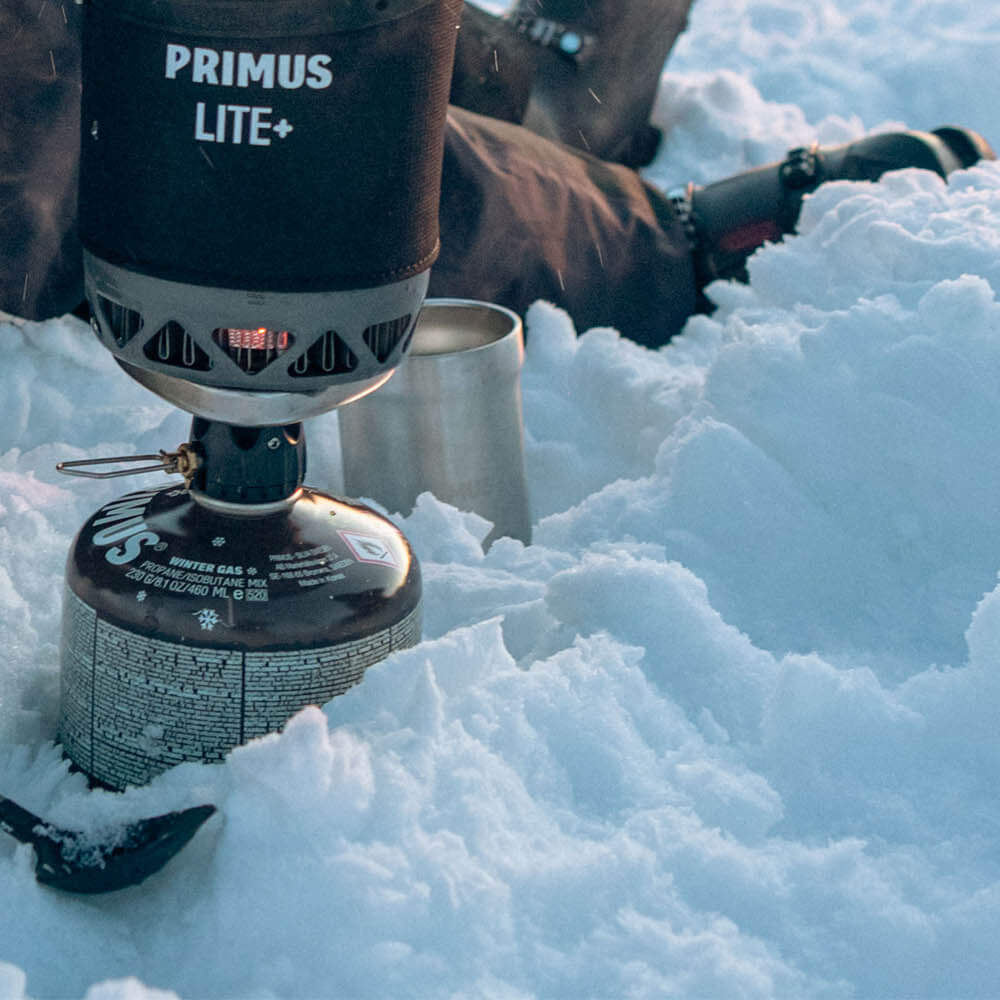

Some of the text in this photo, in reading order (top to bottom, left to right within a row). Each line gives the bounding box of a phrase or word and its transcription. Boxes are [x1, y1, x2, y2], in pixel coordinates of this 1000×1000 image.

[164, 43, 334, 90] PRIMUS
[194, 101, 294, 146] LITE+
[140, 560, 269, 588] PROPANE/ISOBUTANE MIX
[168, 556, 244, 576] WINTER GAS
[212, 587, 230, 599] ML
